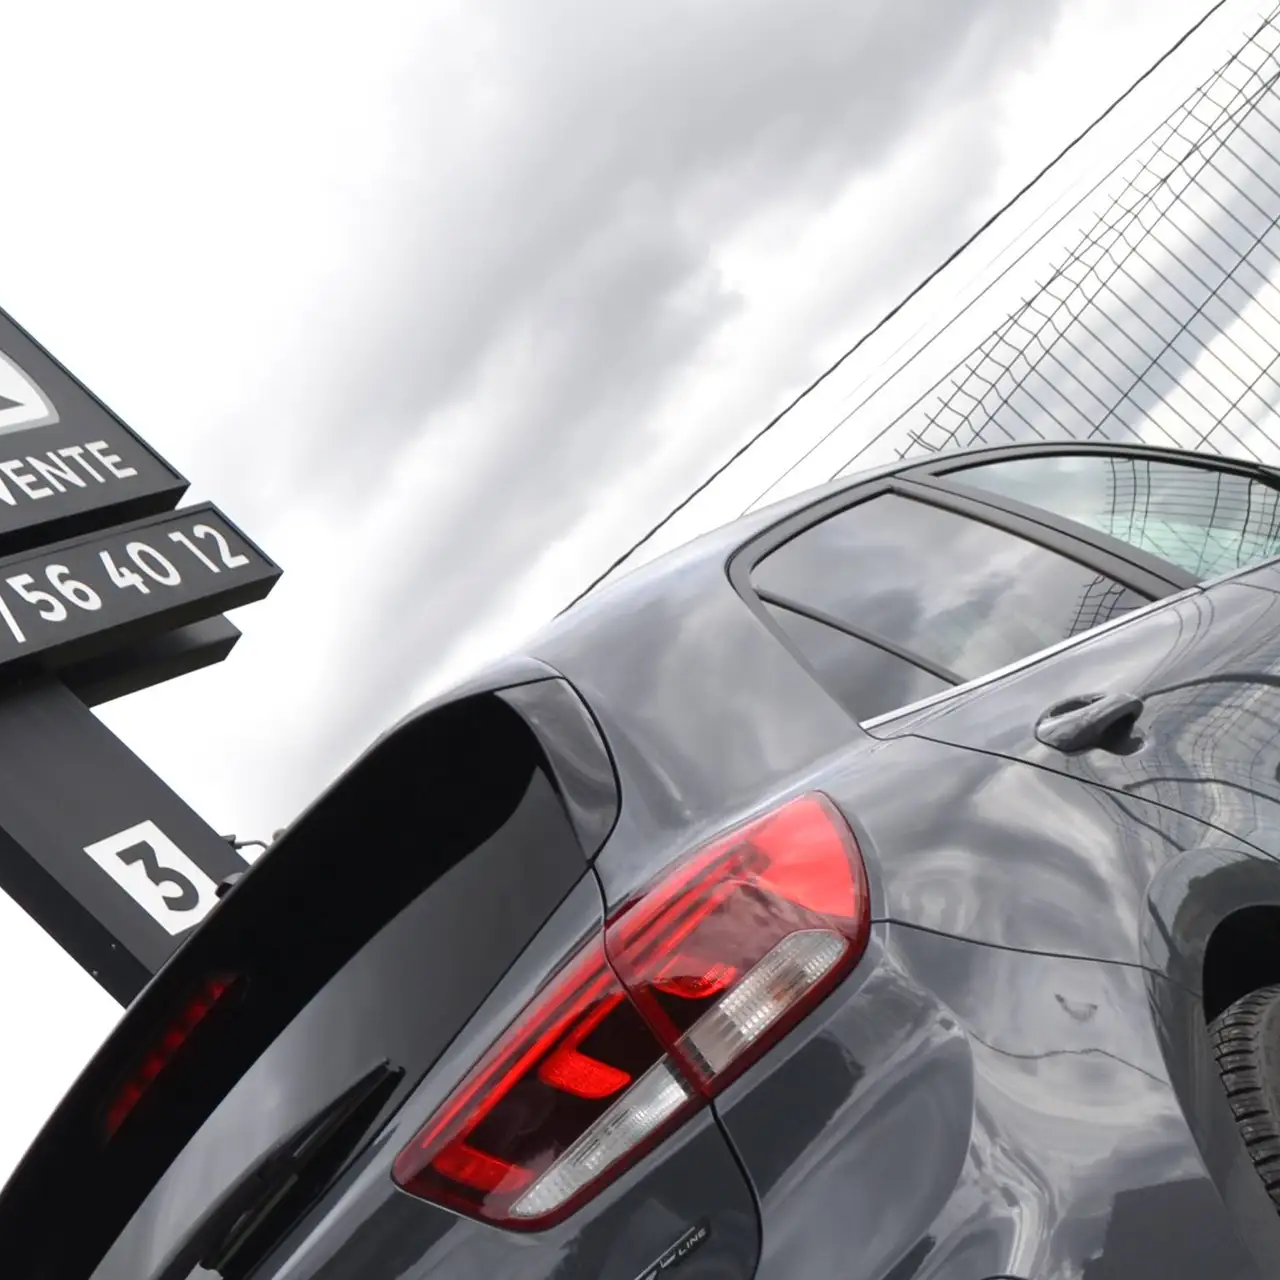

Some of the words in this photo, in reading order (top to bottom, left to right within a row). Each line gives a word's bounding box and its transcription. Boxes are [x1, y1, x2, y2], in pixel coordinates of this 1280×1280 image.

[99, 541, 181, 594] 40
[169, 524, 250, 574] 12
[115, 840, 200, 912] 3
